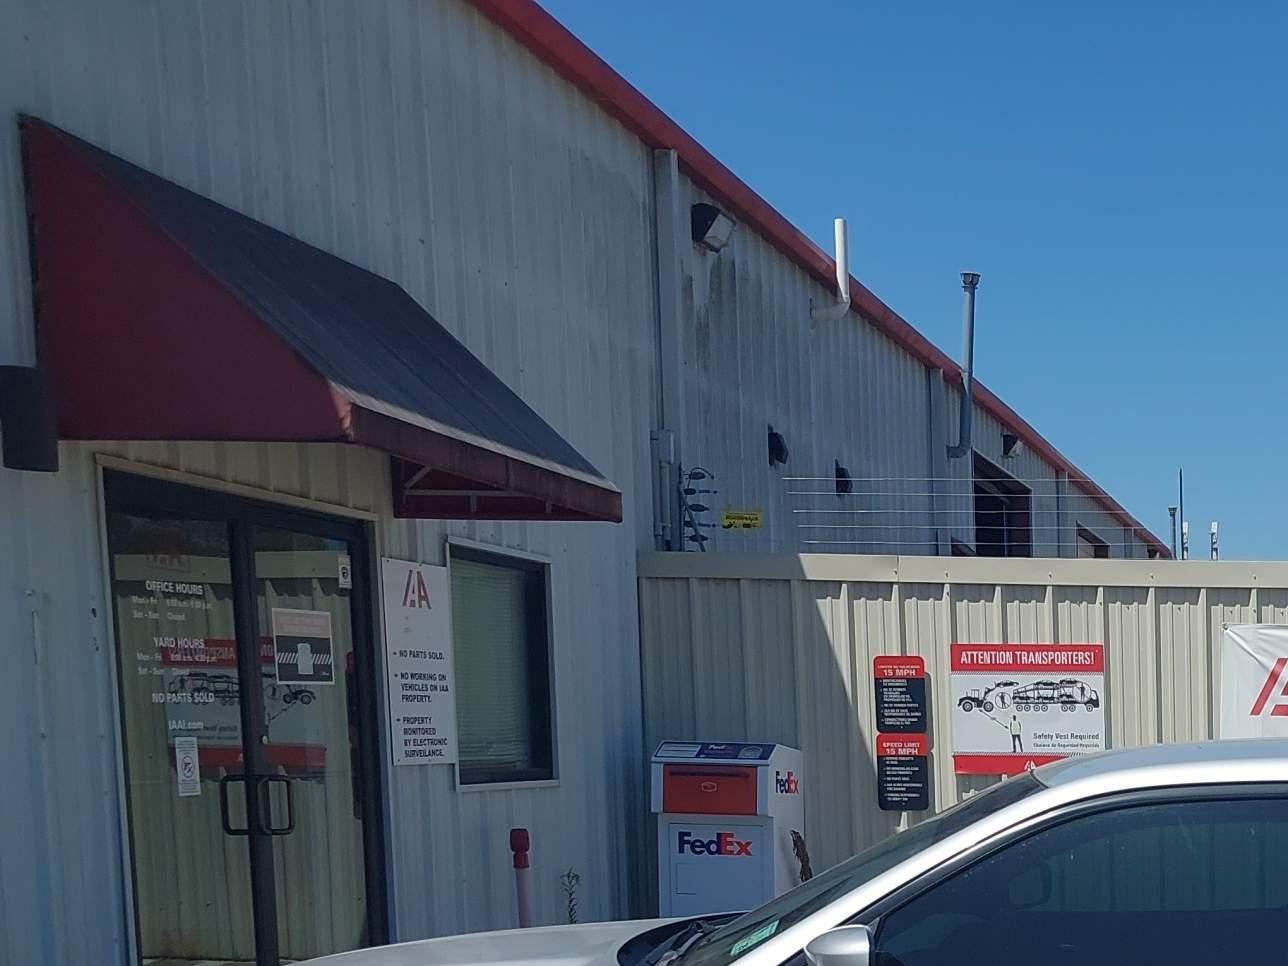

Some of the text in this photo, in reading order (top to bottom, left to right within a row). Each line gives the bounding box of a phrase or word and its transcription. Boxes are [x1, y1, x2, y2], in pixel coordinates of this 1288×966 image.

[145, 580, 203, 595] OFFICE HOURS
[153, 637, 205, 649] YARD HOURS
[399, 650, 408, 659] NO
[409, 651, 427, 660] PARTS
[960, 652, 1095, 665] ATTENTION TRANSPORTERS!
[400, 673, 447, 682] NO WORKING ON
[401, 684, 429, 692] VEHICLES
[430, 684, 439, 692] ON
[152, 692, 215, 703] NO PARTS SOLD
[402, 716, 432, 725] PROPERTY
[404, 728, 436, 736] MONITORED
[1033, 733, 1054, 741] Safety
[1070, 733, 1100, 741] Required
[404, 738, 448, 746] BY ELECTRONIC
[776, 770, 799, 794] FedEx
[678, 832, 753, 856] FedEx
